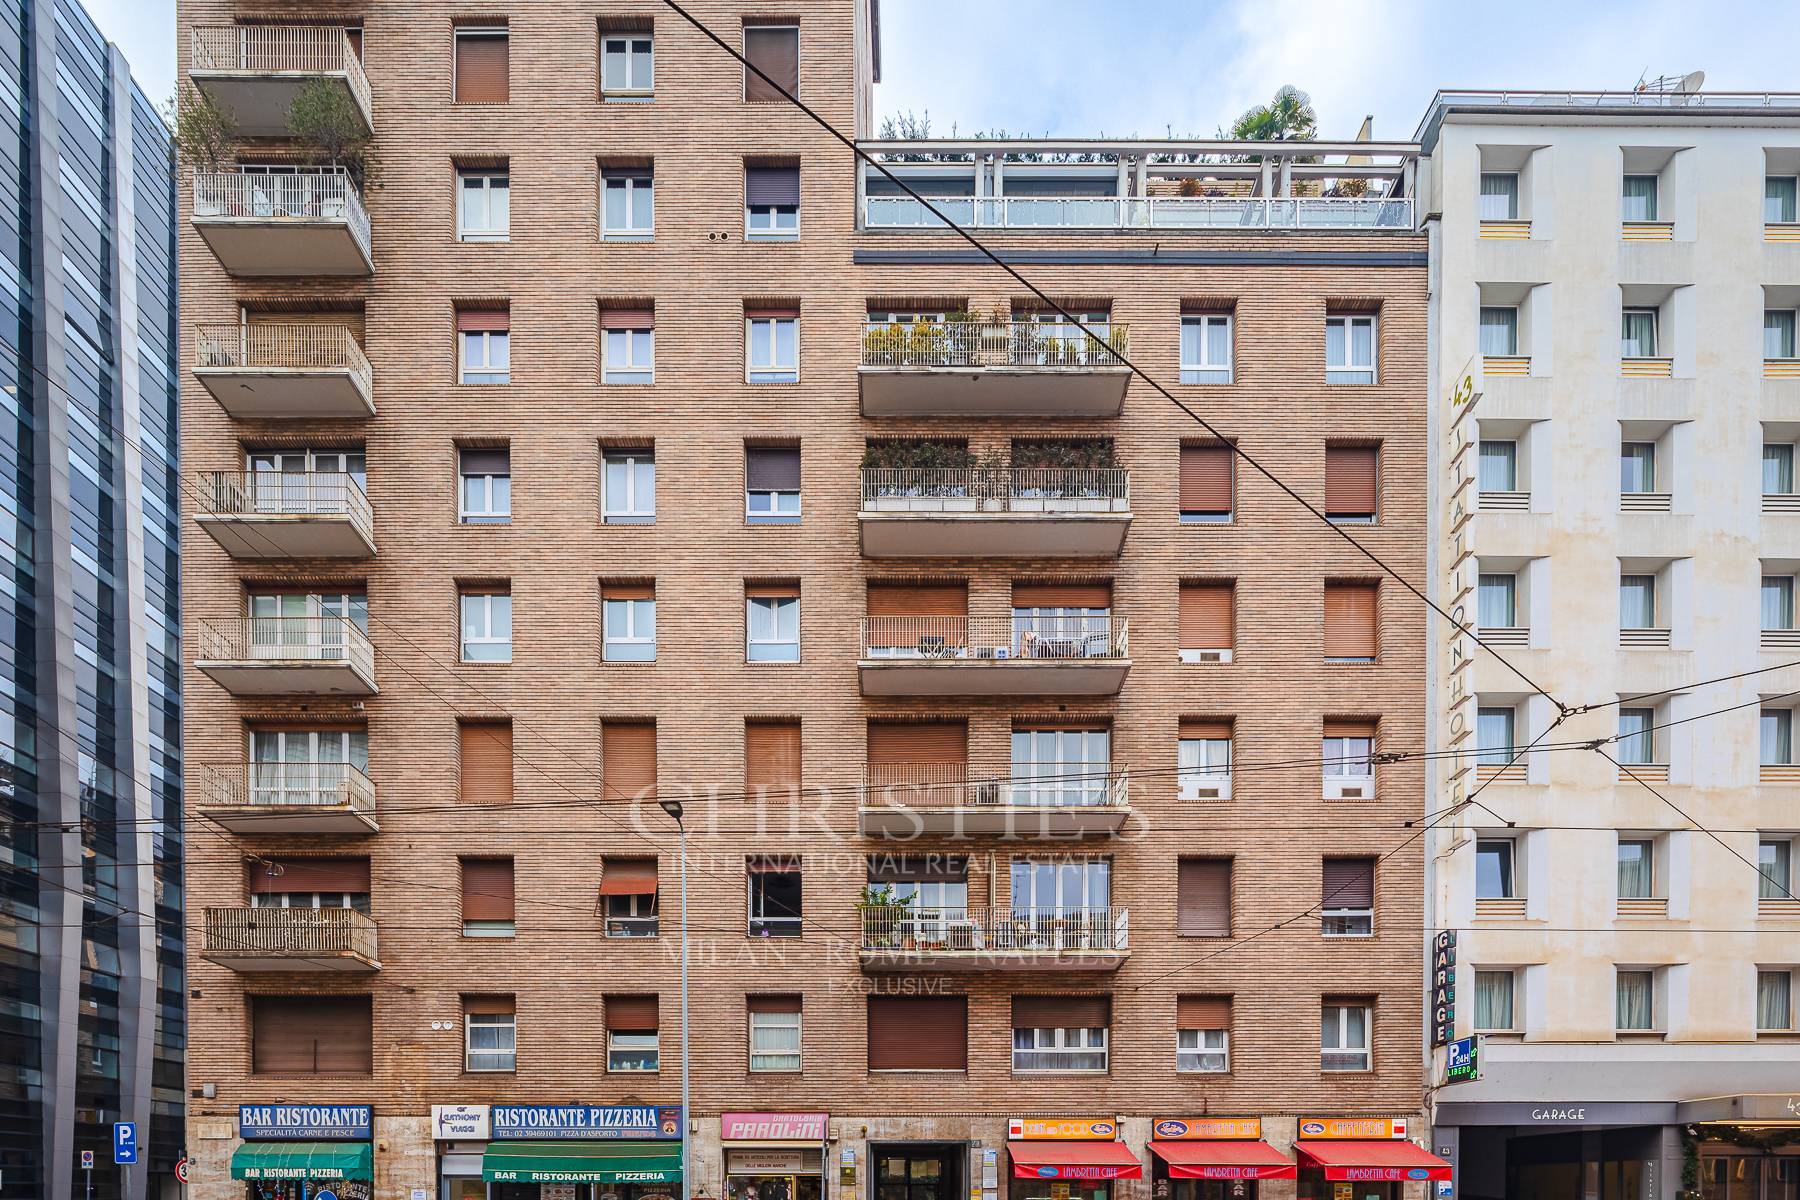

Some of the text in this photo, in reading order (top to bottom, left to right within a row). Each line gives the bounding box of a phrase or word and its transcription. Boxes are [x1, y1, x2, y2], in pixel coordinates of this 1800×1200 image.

[1453, 375, 1472, 408] 43
[1437, 932, 1448, 1041] GARAGE
[1450, 1044, 1469, 1066] P 24H
[1448, 1066, 1470, 1077] LIBERO
[242, 1107, 369, 1126] BAR RISTORANTE
[494, 1108, 586, 1127] RISTORANTE
[590, 1108, 658, 1127] PIZZERIA
[1531, 1108, 1585, 1120] GARAGE
[119, 1125, 132, 1145] P
[299, 1129, 323, 1137] CARNE
[245, 1168, 343, 1178] BAR RISTORANTE PIZZERIA
[494, 1171, 665, 1181] BAR RISTORANTE PIZZERIA
